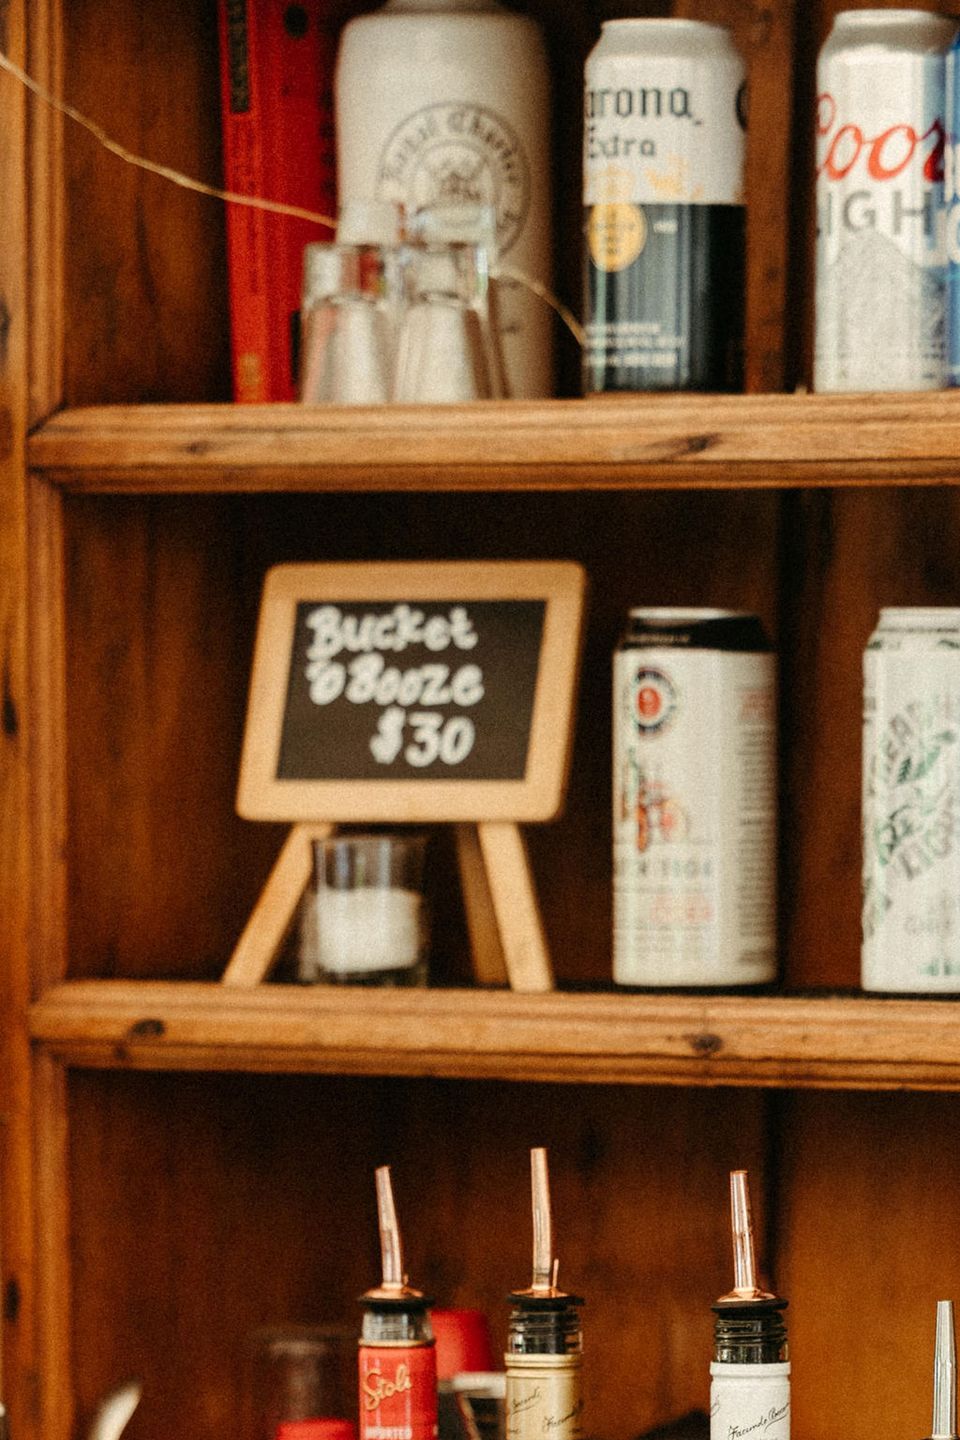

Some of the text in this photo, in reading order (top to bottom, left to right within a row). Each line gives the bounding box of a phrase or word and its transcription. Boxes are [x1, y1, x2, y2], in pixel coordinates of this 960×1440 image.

[306, 604, 479, 661] Bucket
[370, 706, 475, 767] $30
[362, 1363, 412, 1411] Stoli
